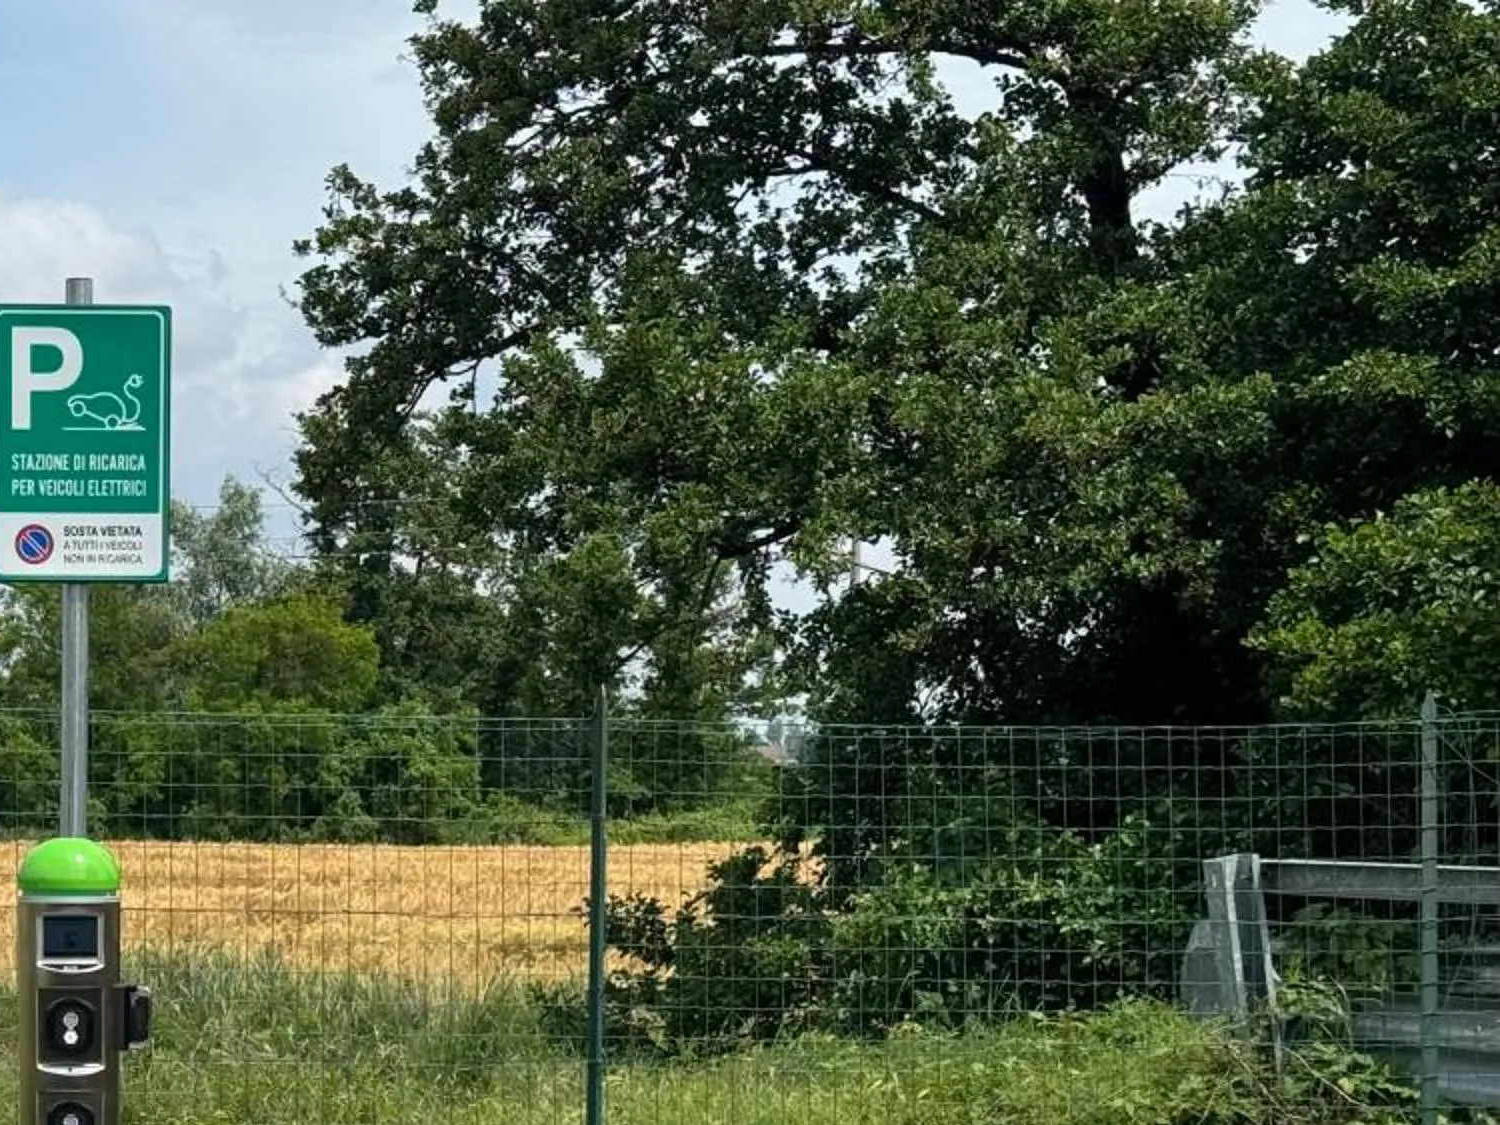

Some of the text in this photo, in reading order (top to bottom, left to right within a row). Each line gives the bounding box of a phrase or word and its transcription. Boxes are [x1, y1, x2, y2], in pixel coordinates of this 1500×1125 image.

[11, 325, 84, 431] P
[11, 453, 146, 471] STAZIONE DI RICARICA
[11, 479, 147, 496] PER VEICOLI ELETTRICI
[63, 525, 142, 537] SOSTA VIETATA
[63, 540, 71, 550] A
[73, 540, 98, 550] TUTTI
[104, 540, 142, 551] VEICOLI
[63, 554, 85, 564] NON
[98, 554, 143, 565] RICARICA
